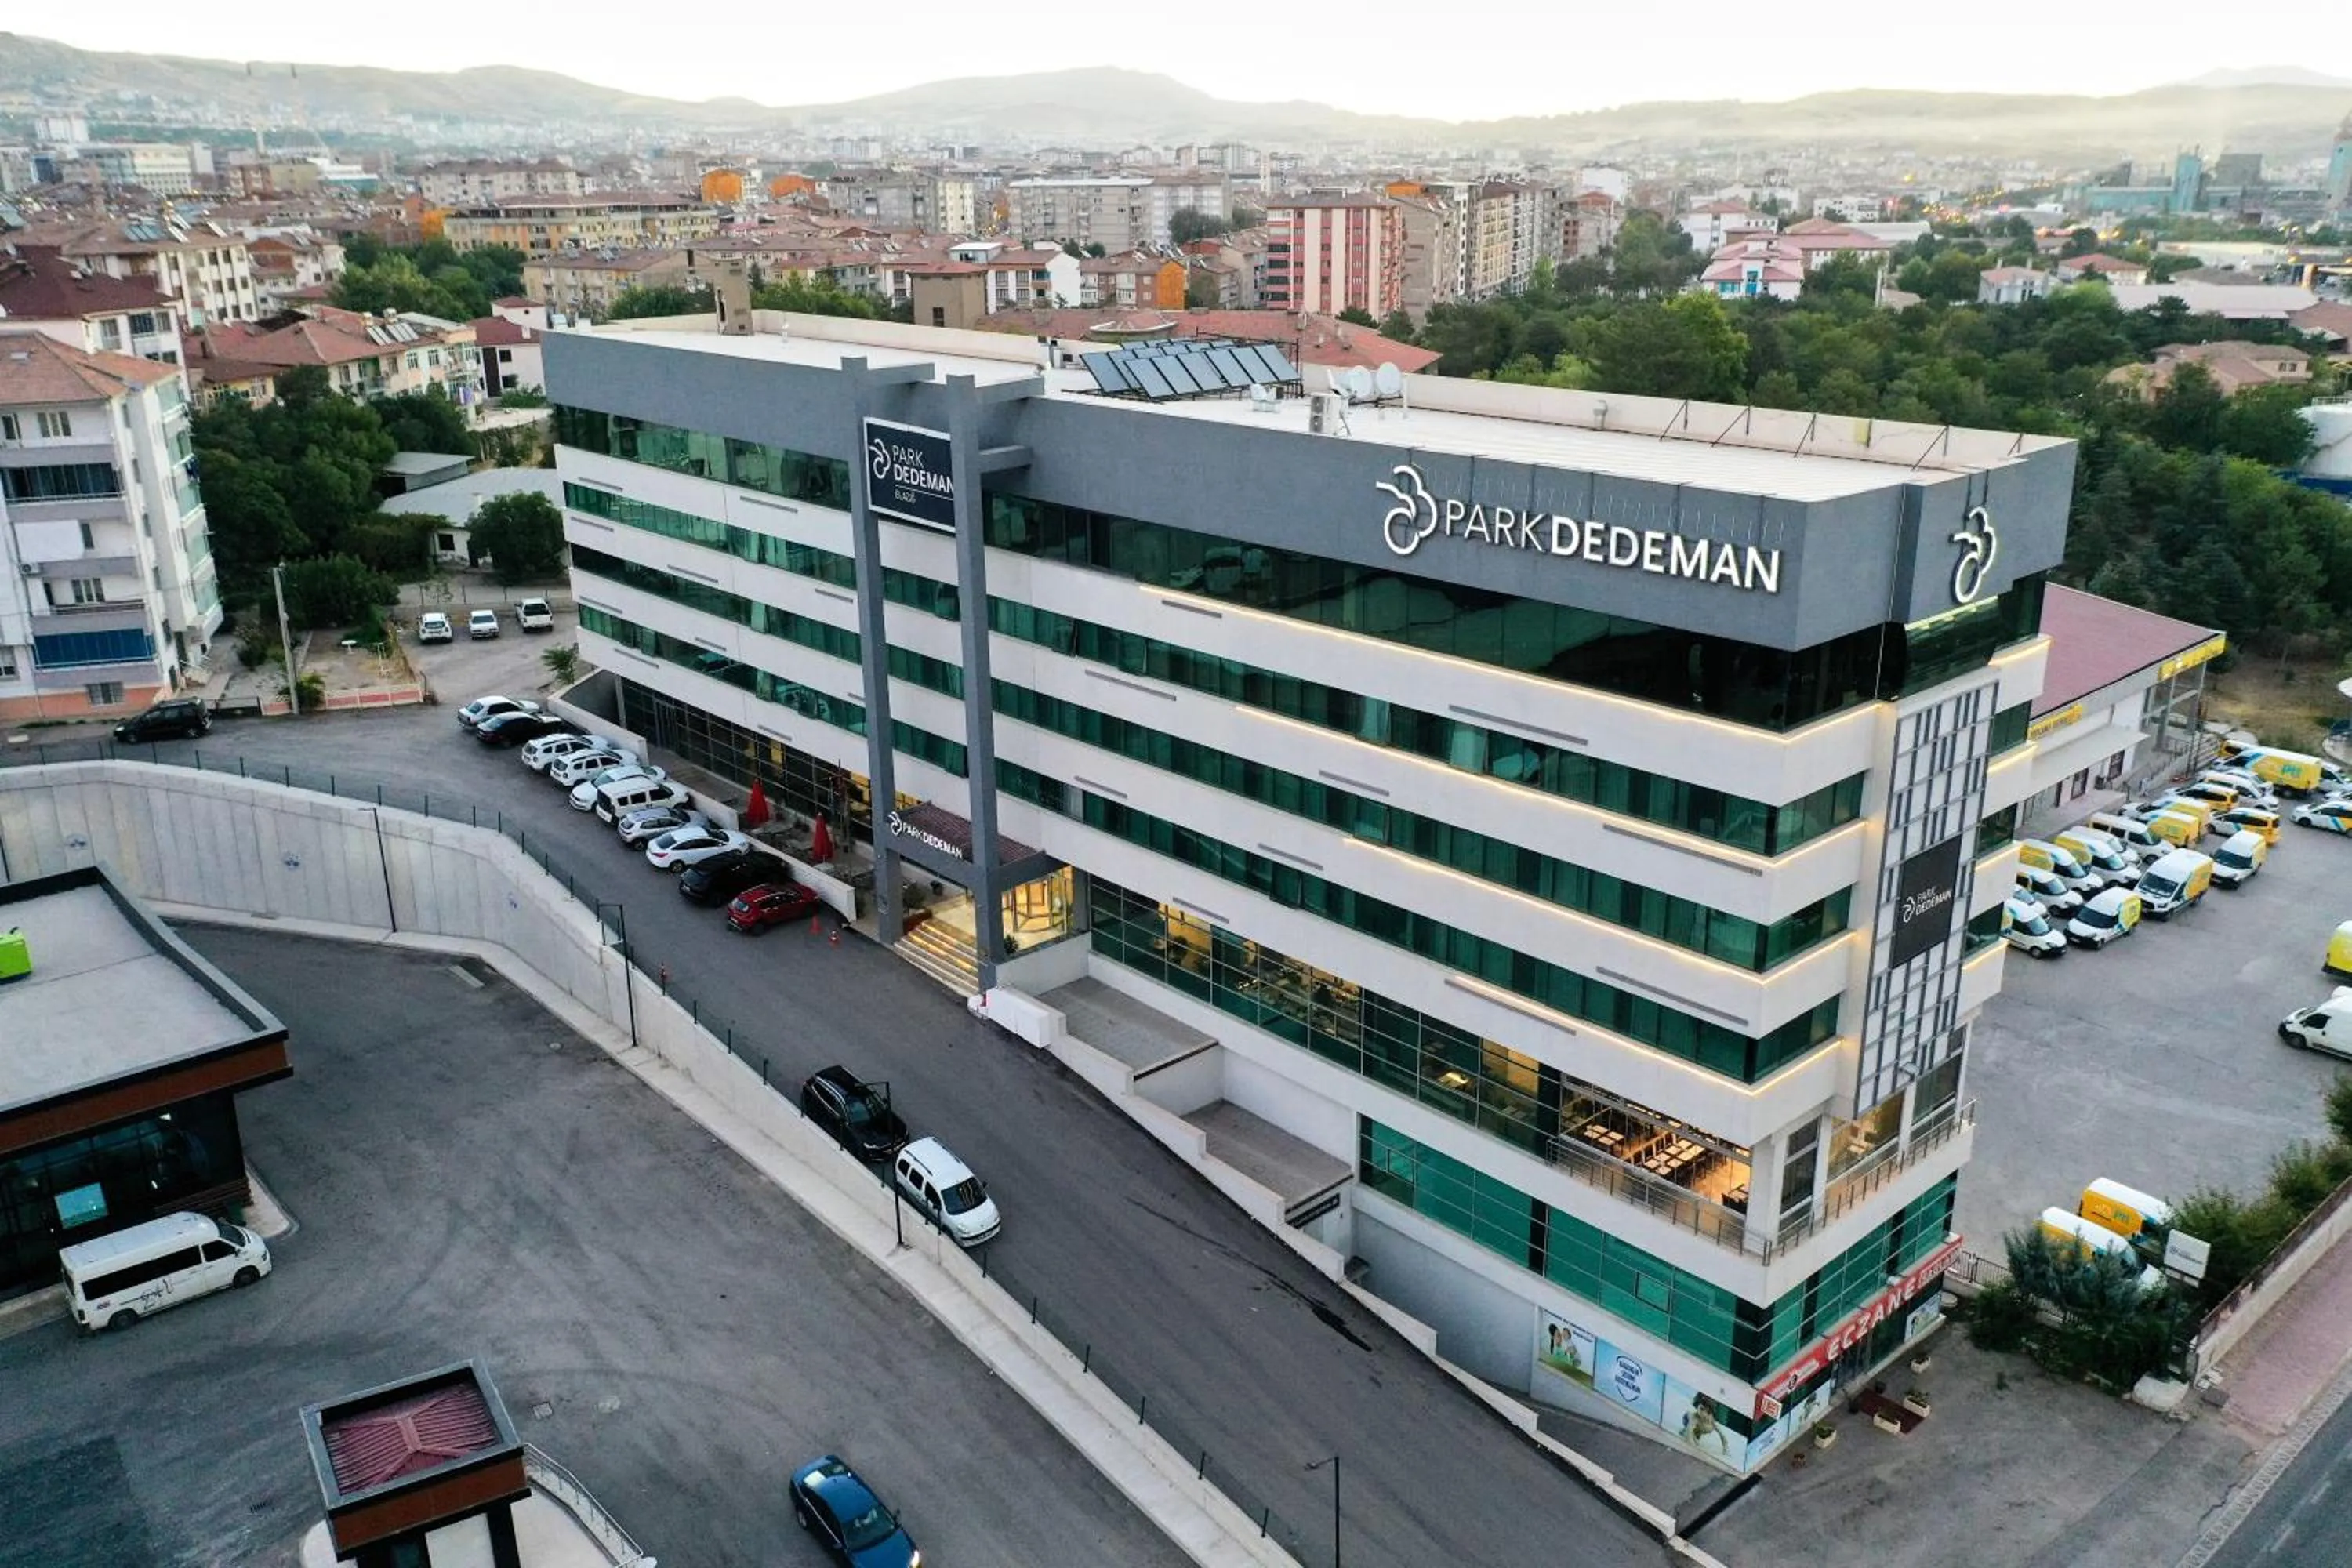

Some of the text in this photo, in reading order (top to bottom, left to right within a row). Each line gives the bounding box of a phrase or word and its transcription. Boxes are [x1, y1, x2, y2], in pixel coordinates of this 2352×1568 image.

[892, 445, 924, 469] PARK
[894, 463, 954, 493] DEDEMAN
[1828, 1275, 1916, 1361] ECZANE
